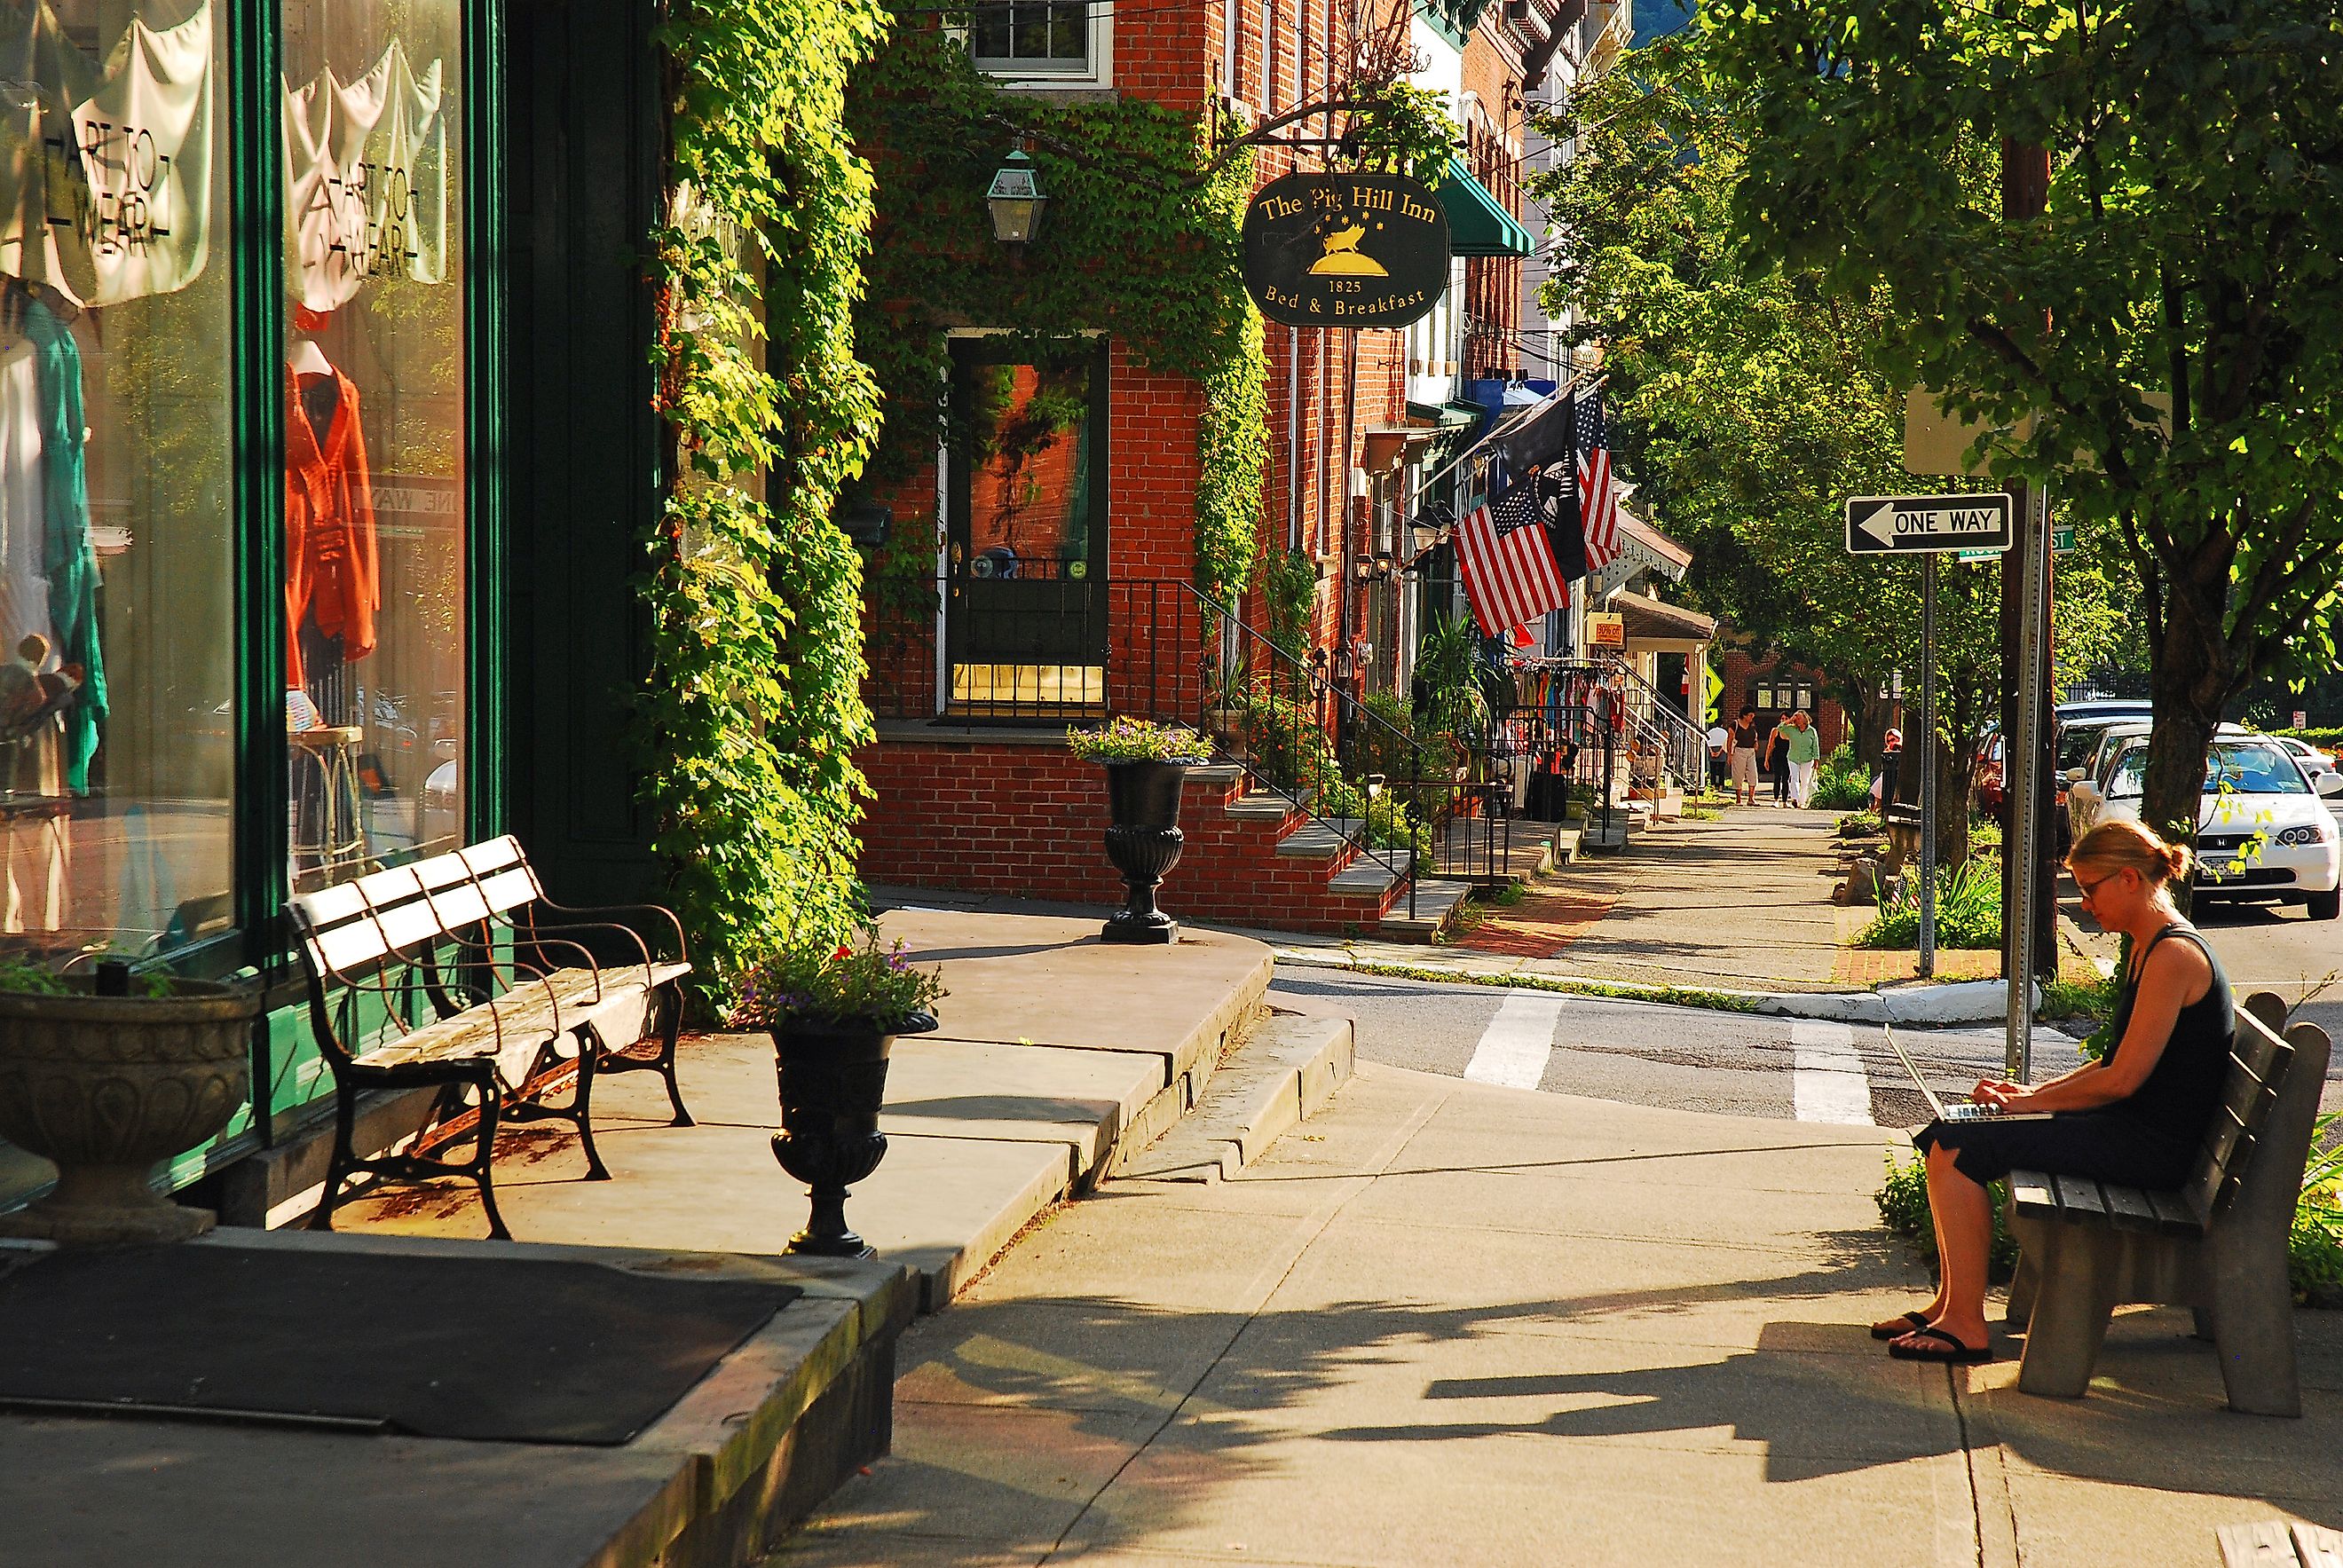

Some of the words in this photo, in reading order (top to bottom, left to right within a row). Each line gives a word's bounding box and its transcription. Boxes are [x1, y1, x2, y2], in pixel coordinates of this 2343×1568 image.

[122, 127, 155, 192] TO
[343, 162, 376, 217] ART
[383, 165, 407, 222] TO
[1258, 193, 1303, 221] The
[1309, 187, 1343, 212] Pig
[1352, 185, 1393, 210] Hill
[1399, 193, 1436, 224] Inn
[1265, 284, 1299, 309] Bed
[1309, 297, 1321, 314] &
[1335, 288, 1425, 315] Breakfast
[1329, 280, 1362, 293] 1825
[1895, 512, 1938, 533] ONE
[1949, 510, 1993, 532] WAY
[2051, 532, 2066, 548] ST
